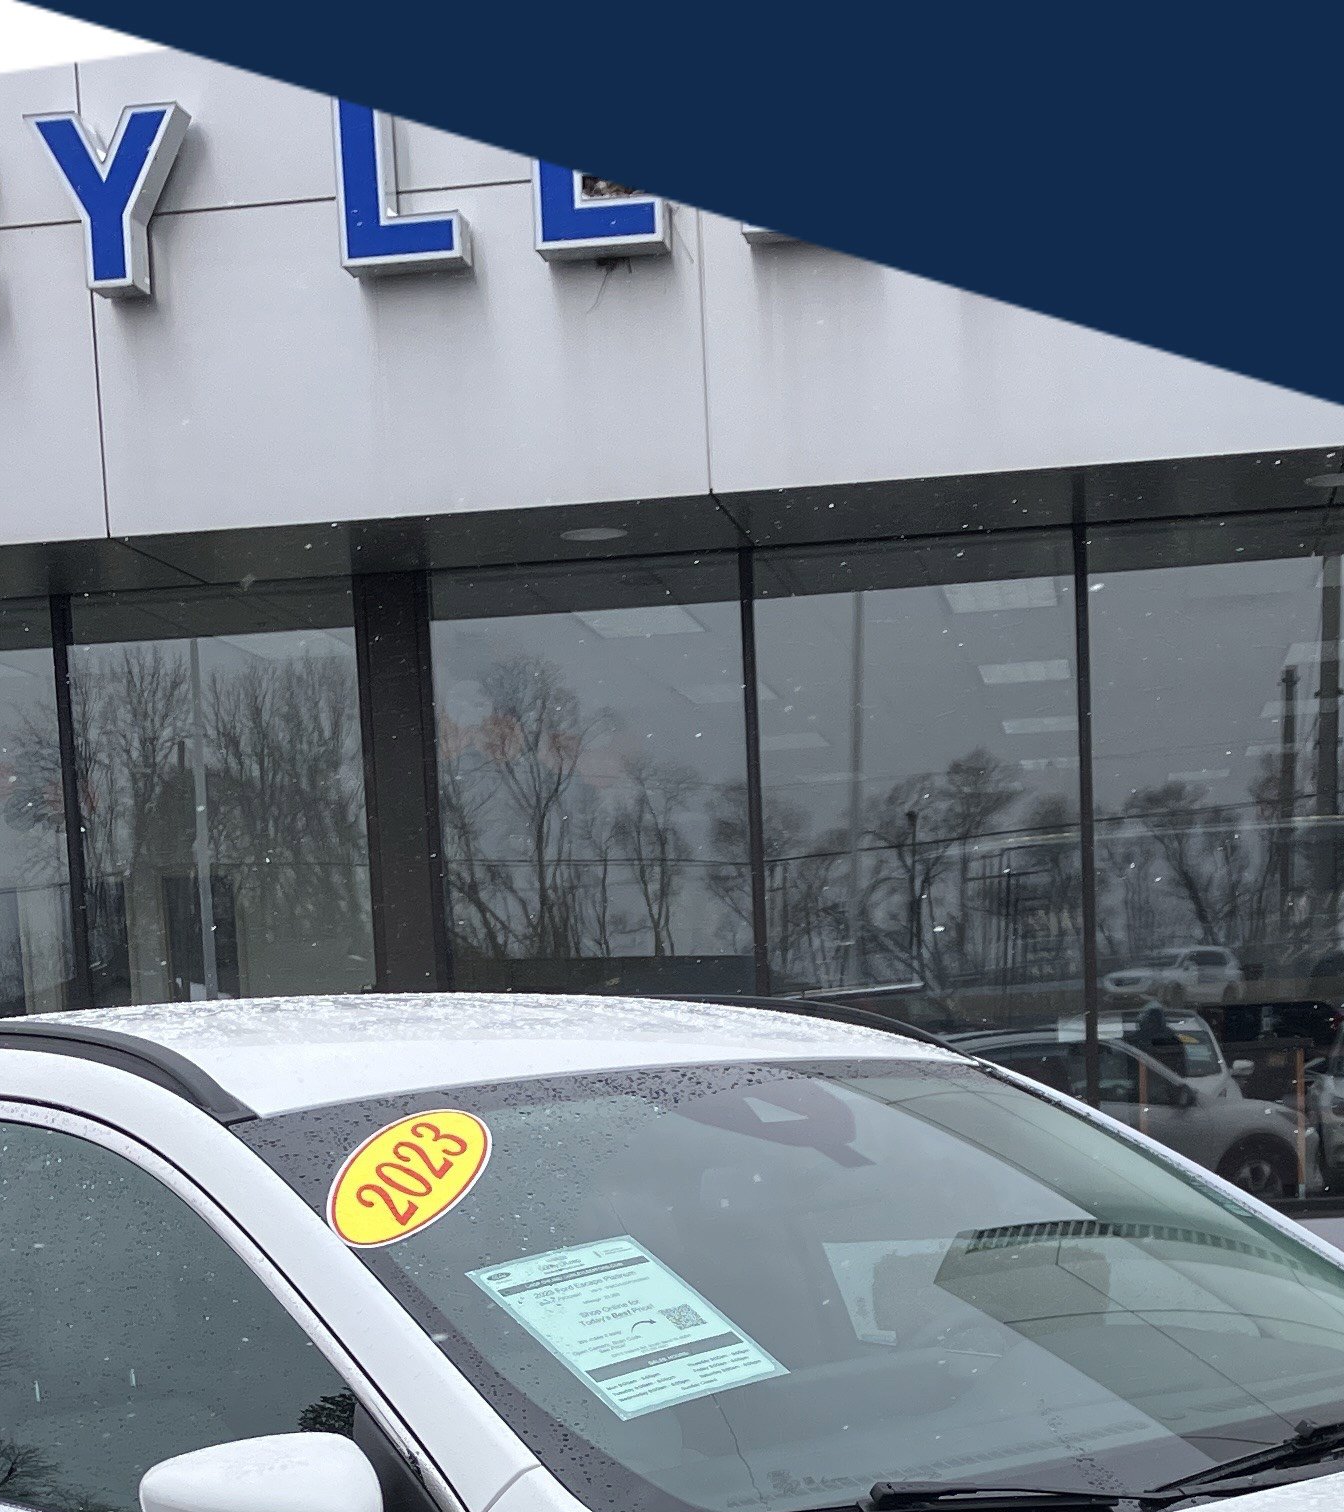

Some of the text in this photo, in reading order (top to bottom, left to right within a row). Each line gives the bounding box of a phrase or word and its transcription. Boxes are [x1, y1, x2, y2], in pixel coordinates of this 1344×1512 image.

[356, 1120, 468, 1226] 2023
[579, 1309, 602, 1317] Shop
[601, 1302, 627, 1311] Online
[578, 1313, 611, 1326] Today's
[610, 1310, 631, 1318] Best
